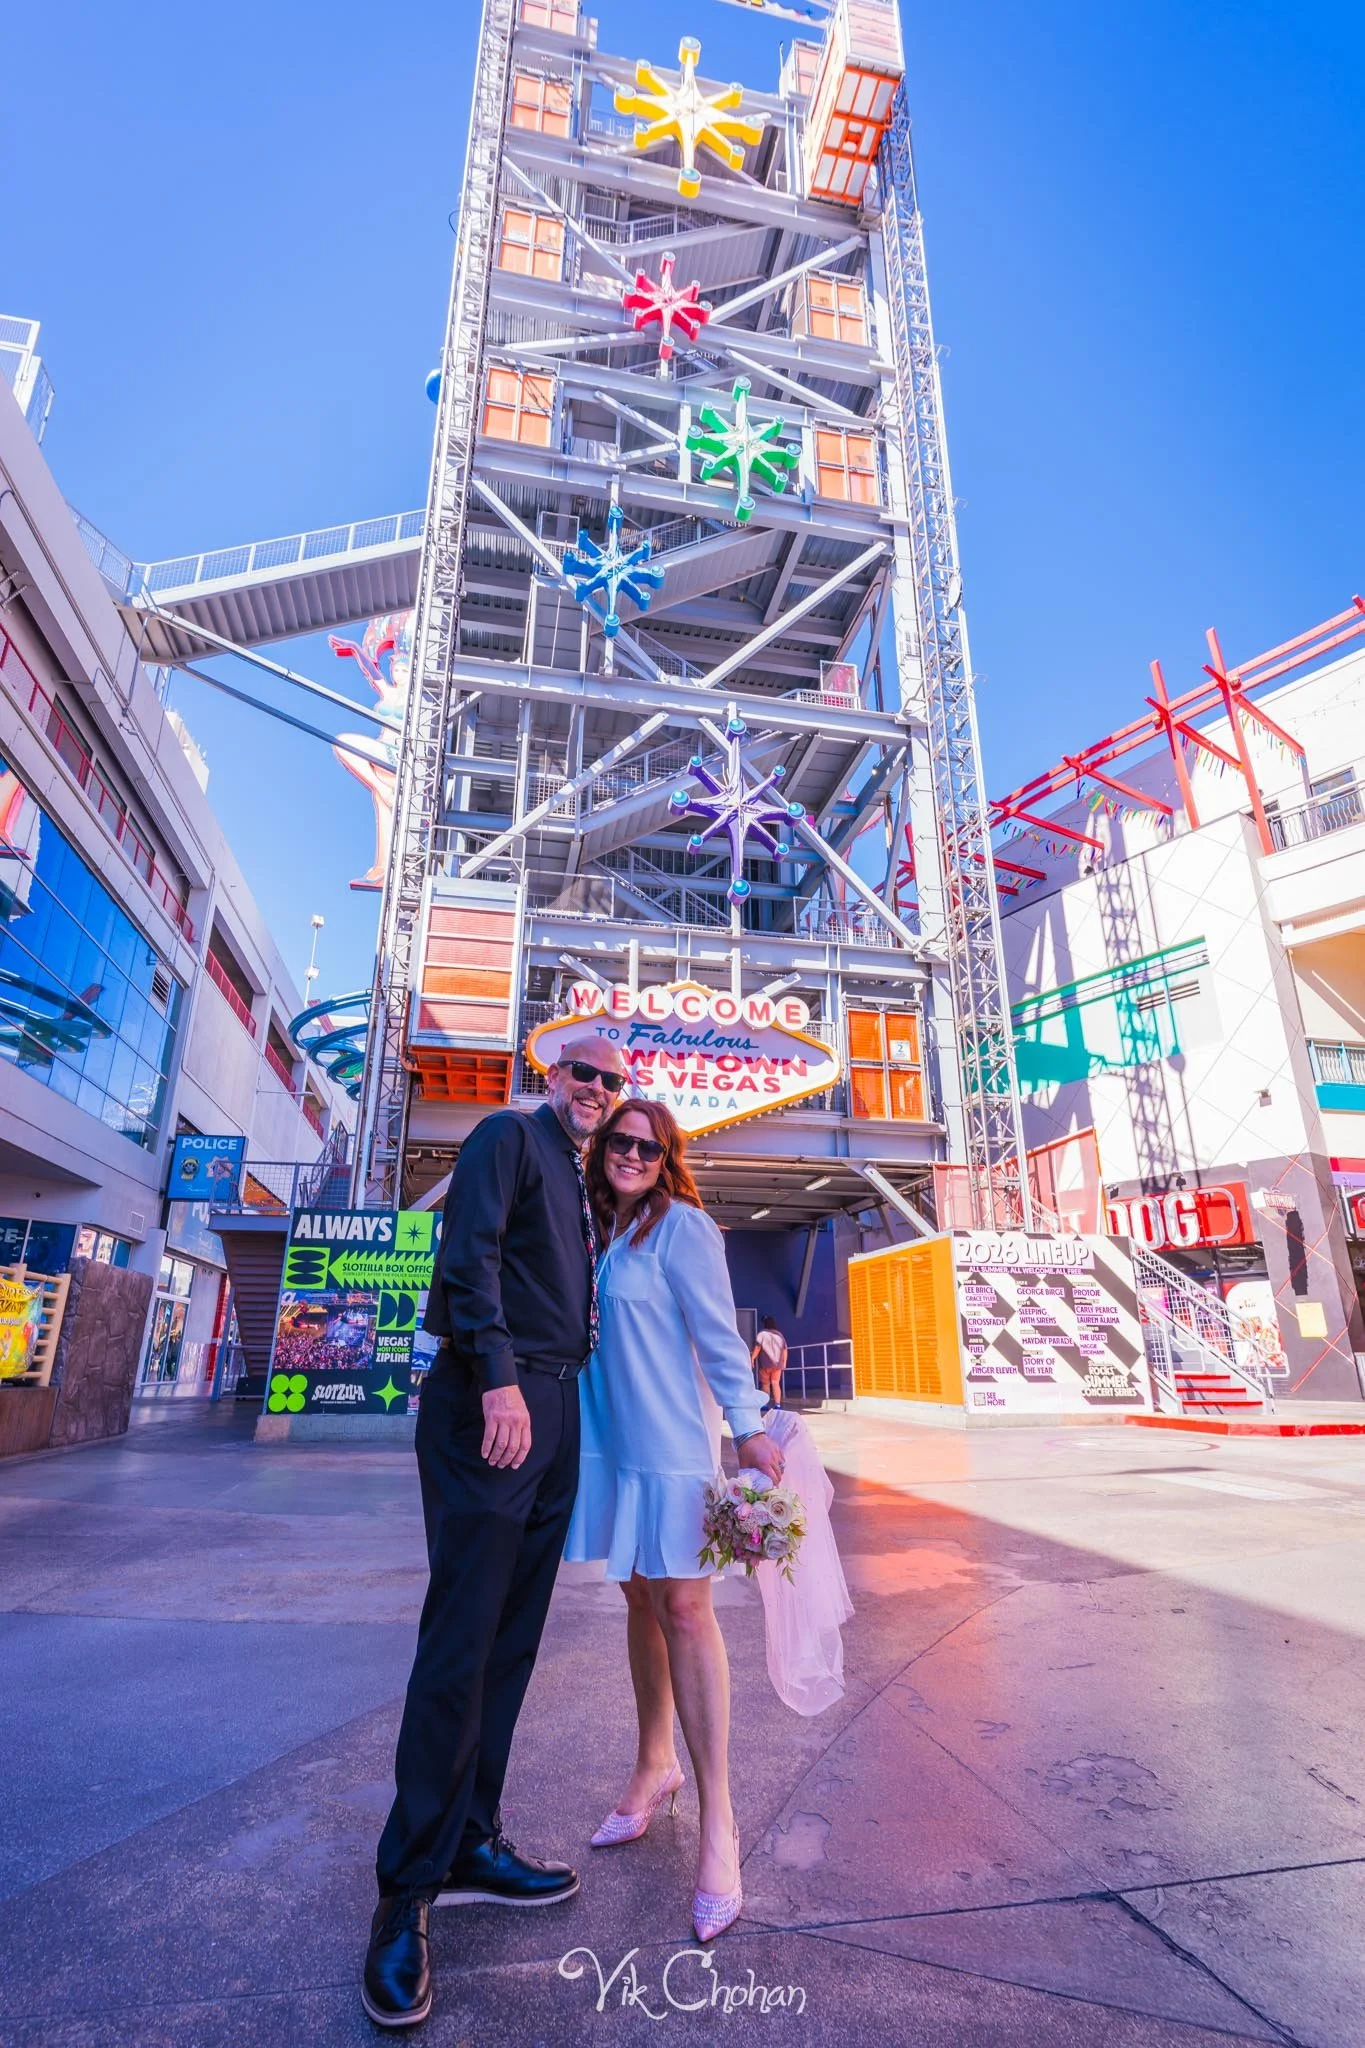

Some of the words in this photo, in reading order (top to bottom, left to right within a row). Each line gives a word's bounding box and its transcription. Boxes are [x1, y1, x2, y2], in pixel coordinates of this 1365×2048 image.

[572, 987, 801, 1023] WELCOME
[596, 1027, 619, 1040] TO
[627, 1022, 759, 1049] Fabulous
[562, 1045, 808, 1077] WNTOWN
[620, 1069, 655, 1086] AS
[667, 1071, 781, 1093] VEGAS
[182, 1137, 237, 1150] POLICE
[294, 1214, 393, 1242] ALWAYS
[958, 1240, 1019, 1265] 2026
[1024, 1240, 1090, 1266] LINEUP
[342, 1263, 383, 1272] SLOTZILLA
[386, 1264, 404, 1273] BOX
[406, 1265, 432, 1274] OFFIC
[968, 1318, 1006, 1326] CROSSFADE
[376, 1352, 410, 1363] ZIPLINE
[1084, 1375, 1128, 1388] SUMMER
[1080, 1387, 1113, 1396] CONCERT
[1114, 1388, 1137, 1396] SERIES
